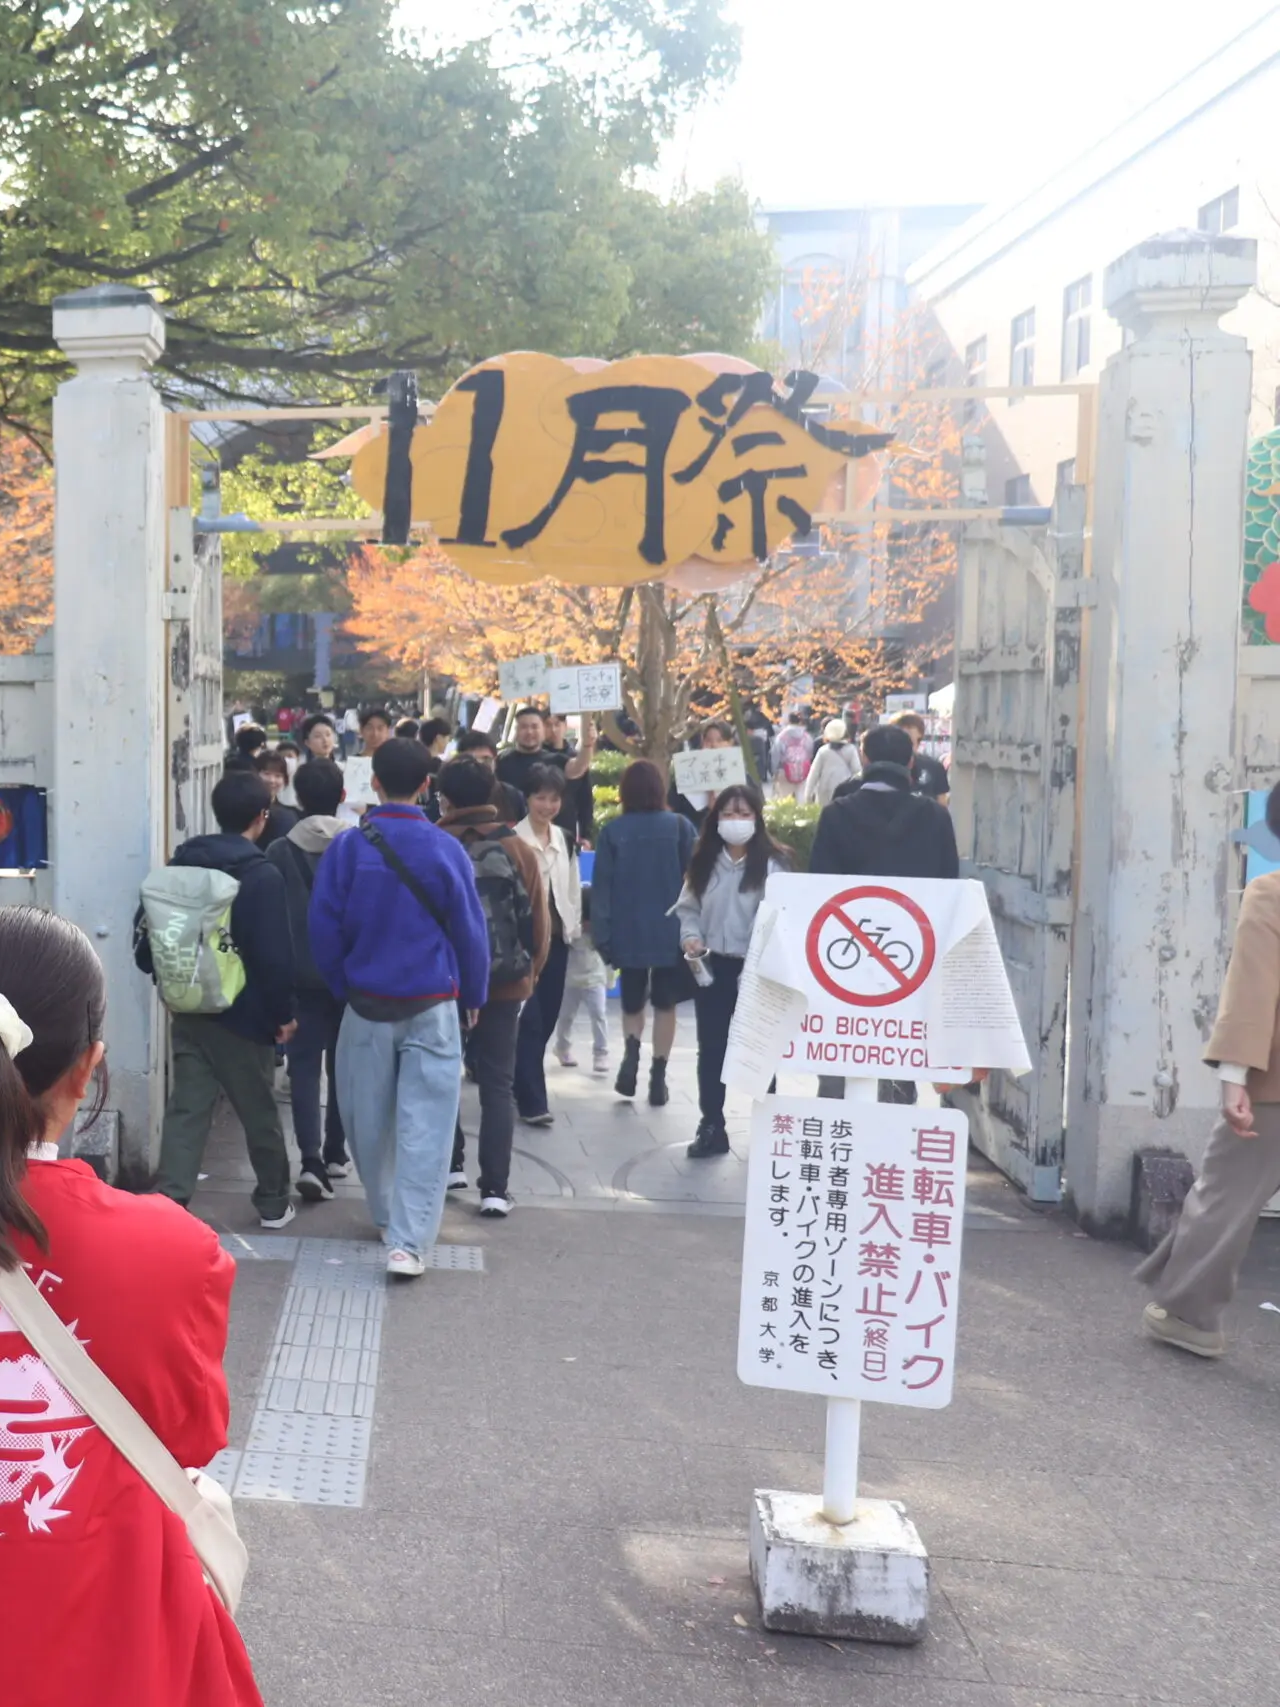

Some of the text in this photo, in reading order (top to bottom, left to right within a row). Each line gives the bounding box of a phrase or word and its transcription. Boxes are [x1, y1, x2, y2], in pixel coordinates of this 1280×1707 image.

[366, 369, 896, 565] 11月祭
[807, 1041, 963, 1070] MOTORCYCL
[759, 1271, 780, 1363] 京都大学
[789, 1117, 824, 1354] 自転車・バイクの進入を
[816, 1119, 853, 1381] 歩行者専用ゾーンにつき、
[902, 1125, 955, 1390] 自転車・バイク
